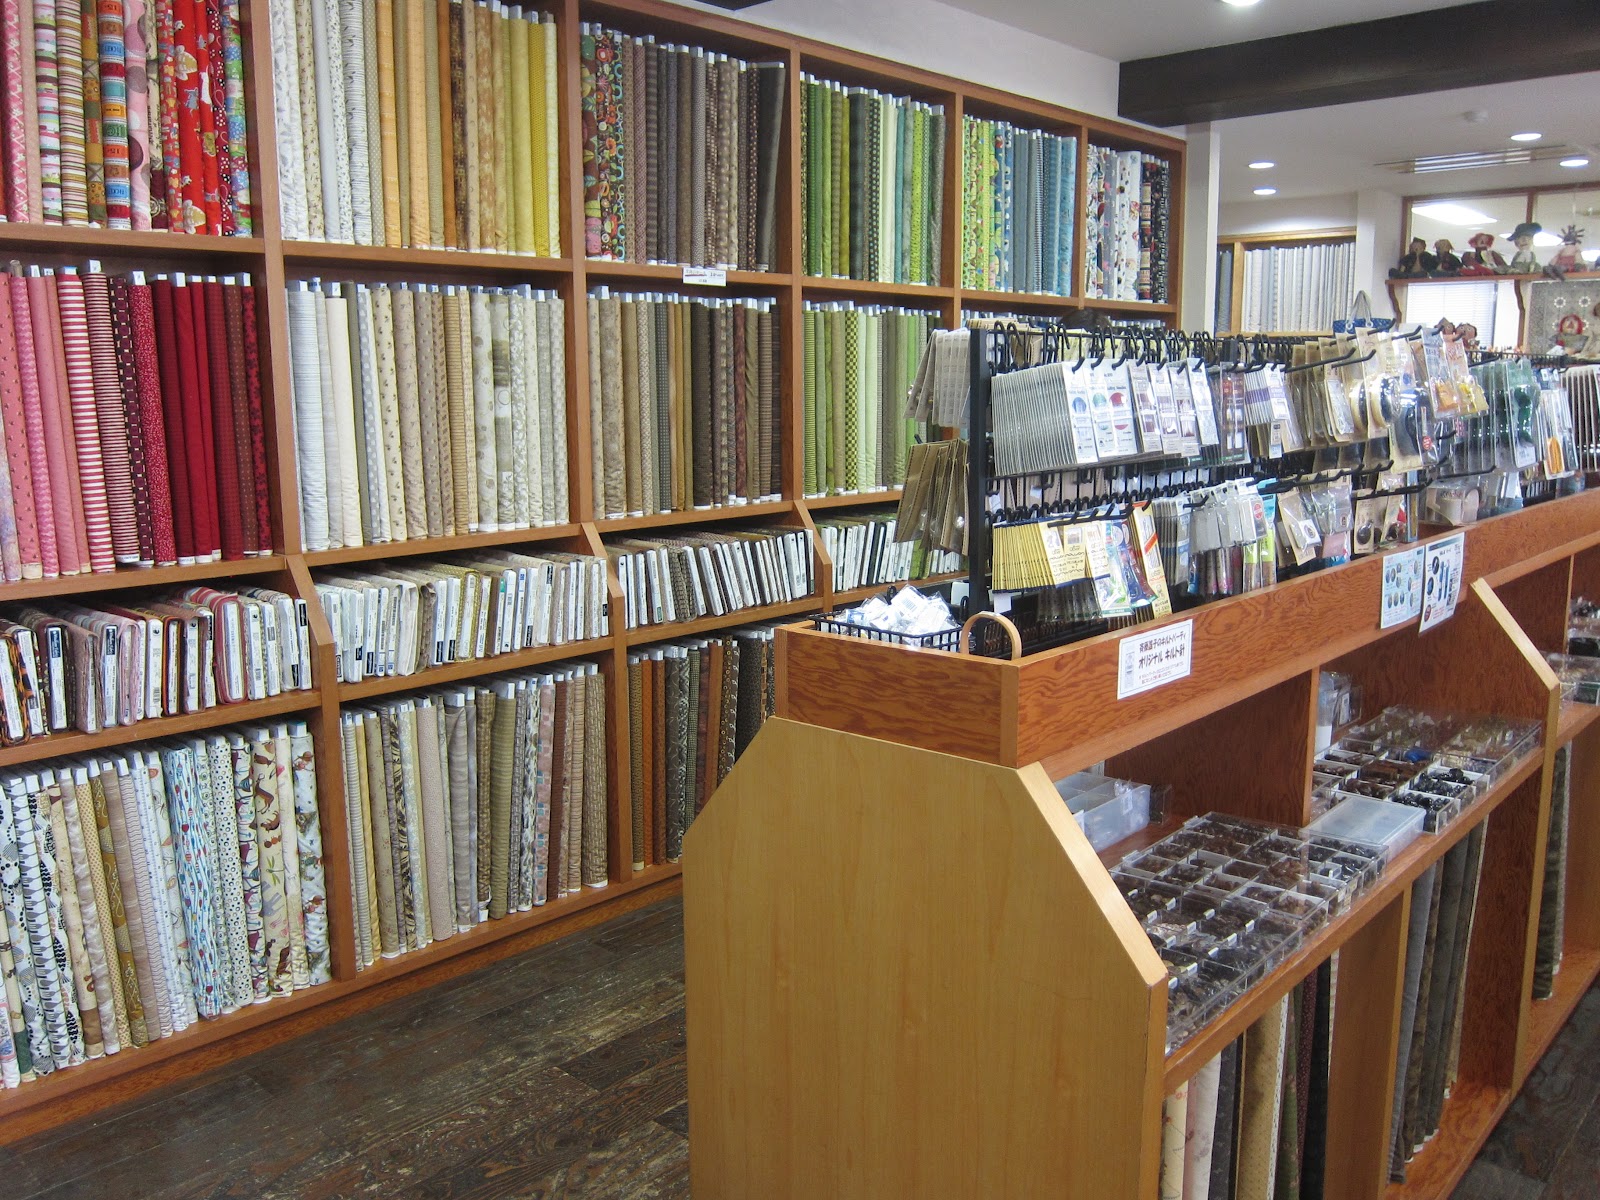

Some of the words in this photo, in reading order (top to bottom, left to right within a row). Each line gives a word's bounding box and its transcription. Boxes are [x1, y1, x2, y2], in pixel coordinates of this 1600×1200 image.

[1138, 651, 1163, 669] オリジナル
